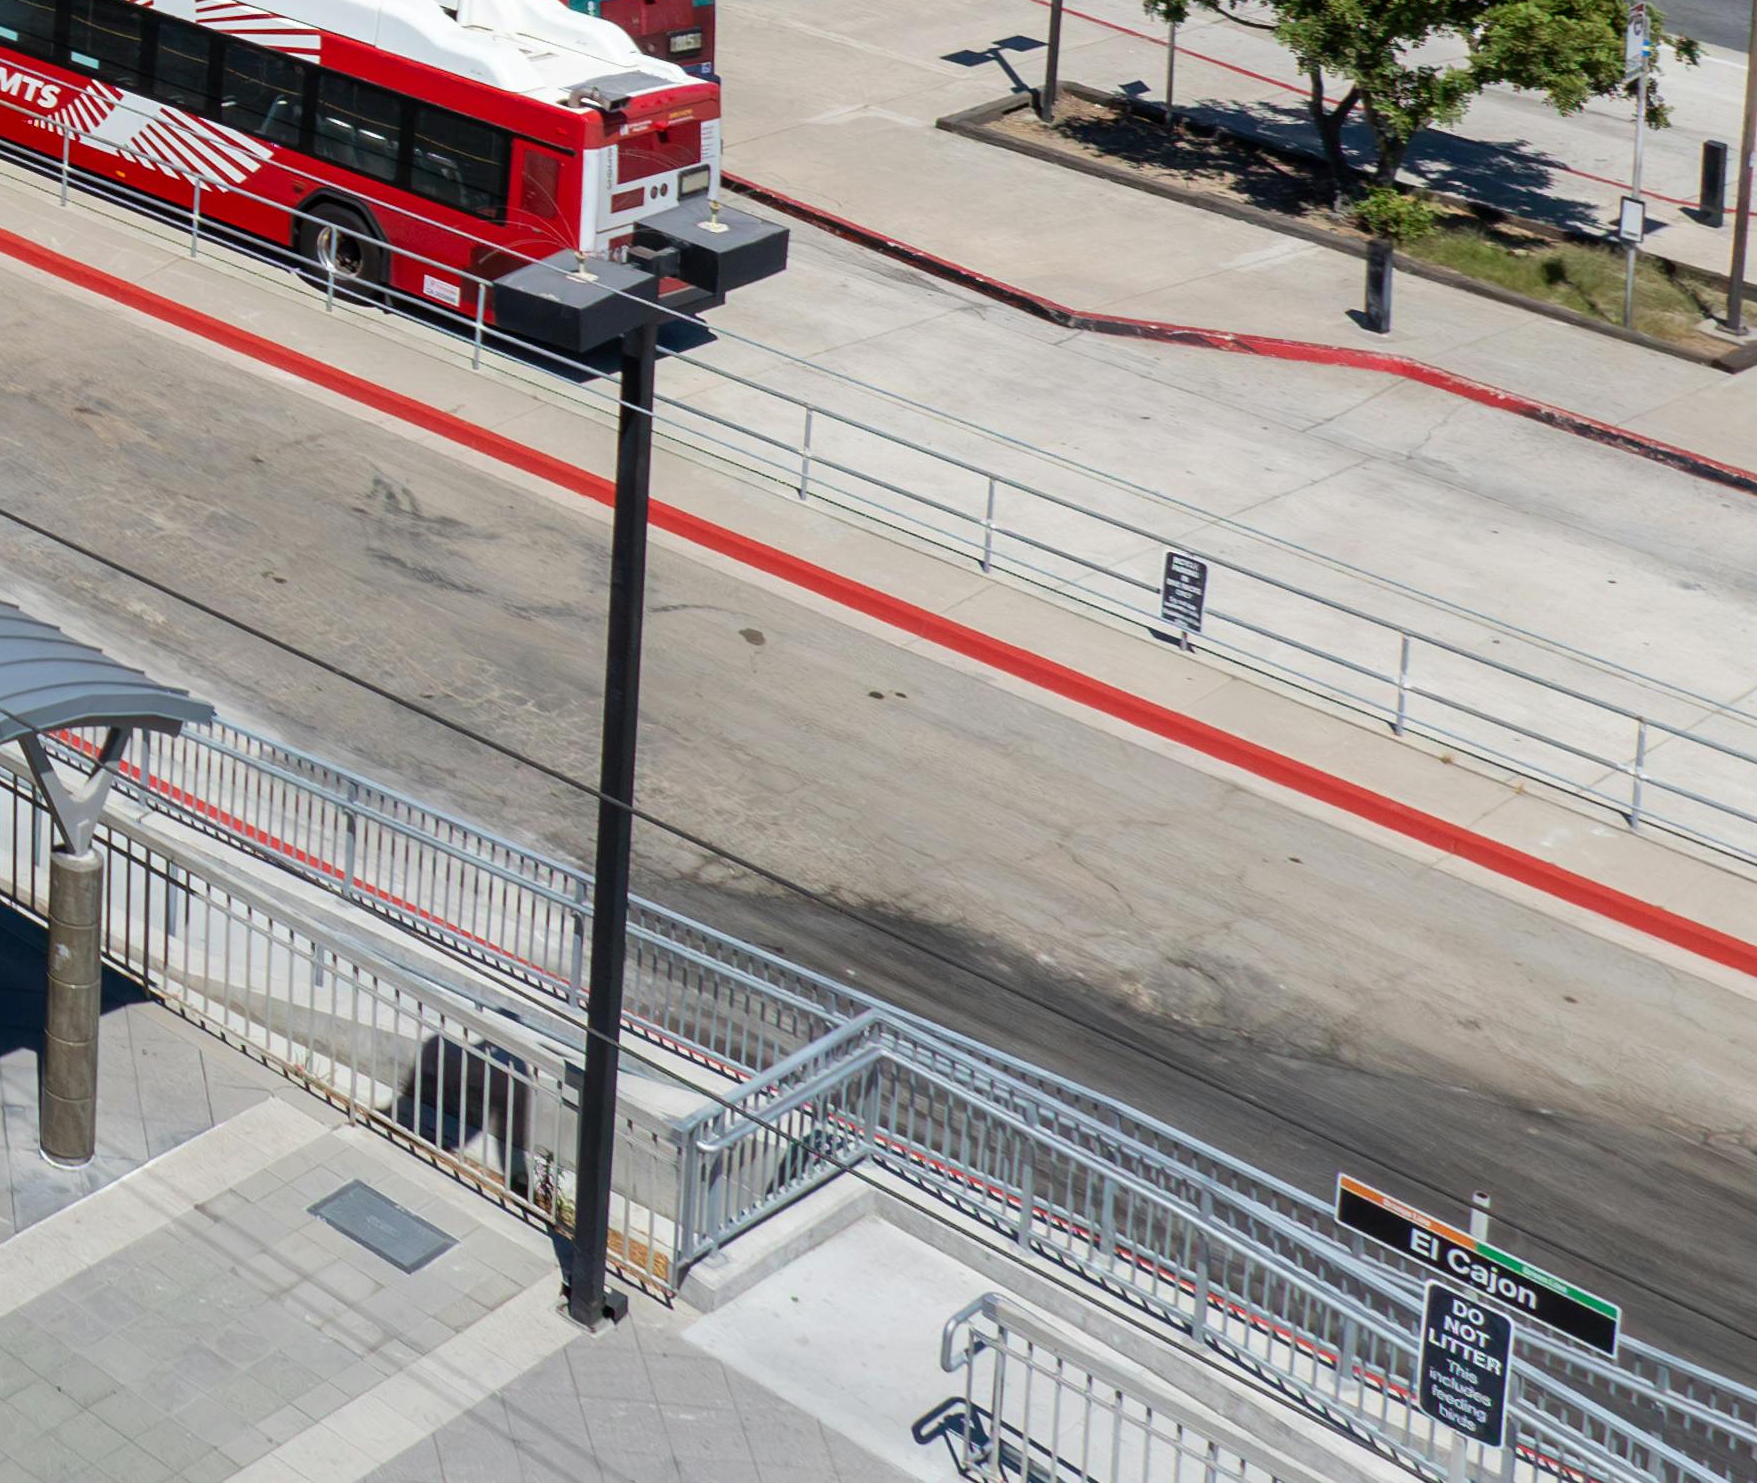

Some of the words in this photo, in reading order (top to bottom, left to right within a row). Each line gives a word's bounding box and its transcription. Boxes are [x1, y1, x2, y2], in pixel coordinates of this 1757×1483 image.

[1410, 1227, 1439, 1261] El
[1447, 1248, 1538, 1309] Cajon
[1452, 1298, 1485, 1326] DO
[1443, 1314, 1491, 1349] NOT
[1428, 1326, 1503, 1377] LITTER
[1429, 1365, 1493, 1408] includes
[1447, 1358, 1479, 1386] This
[1431, 1383, 1488, 1424] feeding
[1438, 1403, 1477, 1432] birds
